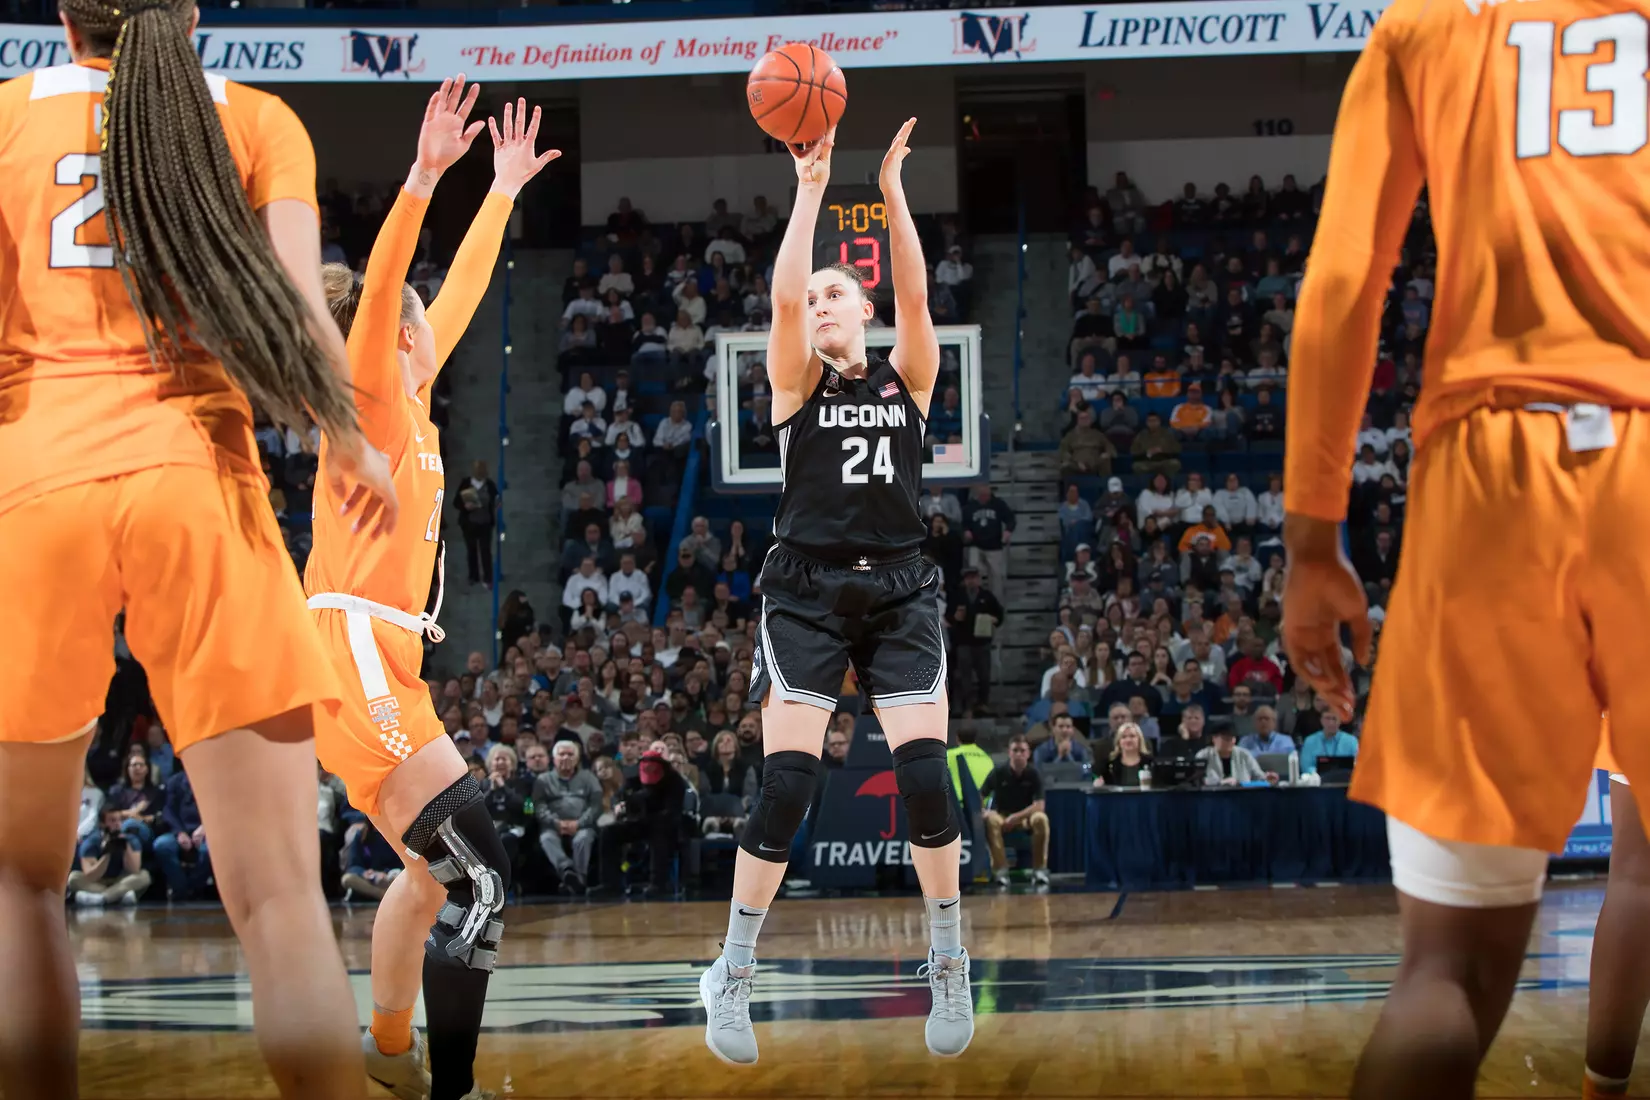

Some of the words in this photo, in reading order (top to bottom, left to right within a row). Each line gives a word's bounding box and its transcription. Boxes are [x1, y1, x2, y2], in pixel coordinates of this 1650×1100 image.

[460, 45, 515, 67] “The
[522, 43, 633, 69] Definition
[640, 39, 666, 66] of
[673, 36, 758, 61] Moving
[764, 29, 899, 54] Eellence”
[952, 16, 1037, 56] LVL
[1078, 10, 1286, 49] LIPPINCOTT
[0, 38, 73, 69] COT
[195, 33, 305, 70] LINES
[341, 35, 425, 74] LVL
[1506, 10, 1650, 160] 13
[1252, 117, 1295, 137] 110
[48, 153, 130, 268] 2
[828, 202, 888, 233] 7:09
[818, 404, 907, 428] UCONN
[841, 435, 895, 484] 24
[813, 840, 972, 867] TRAVELS
